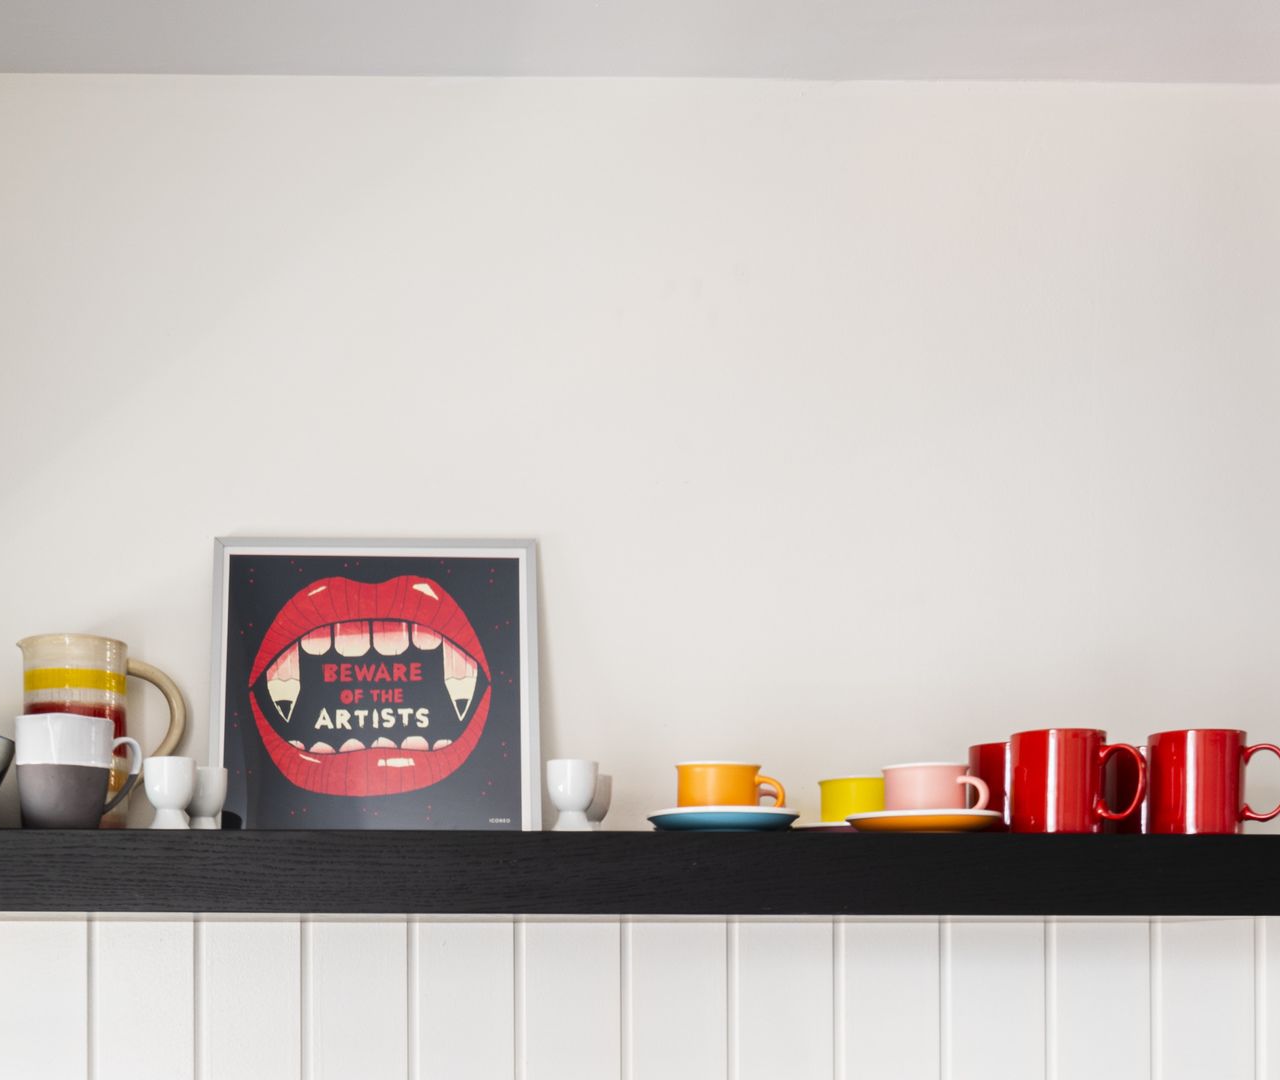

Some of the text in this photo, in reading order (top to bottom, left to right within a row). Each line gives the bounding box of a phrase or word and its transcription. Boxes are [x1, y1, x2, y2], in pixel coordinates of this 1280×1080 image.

[322, 662, 423, 682] BEWARE
[340, 688, 404, 704] OF THE
[314, 707, 430, 730] ARTISTS
